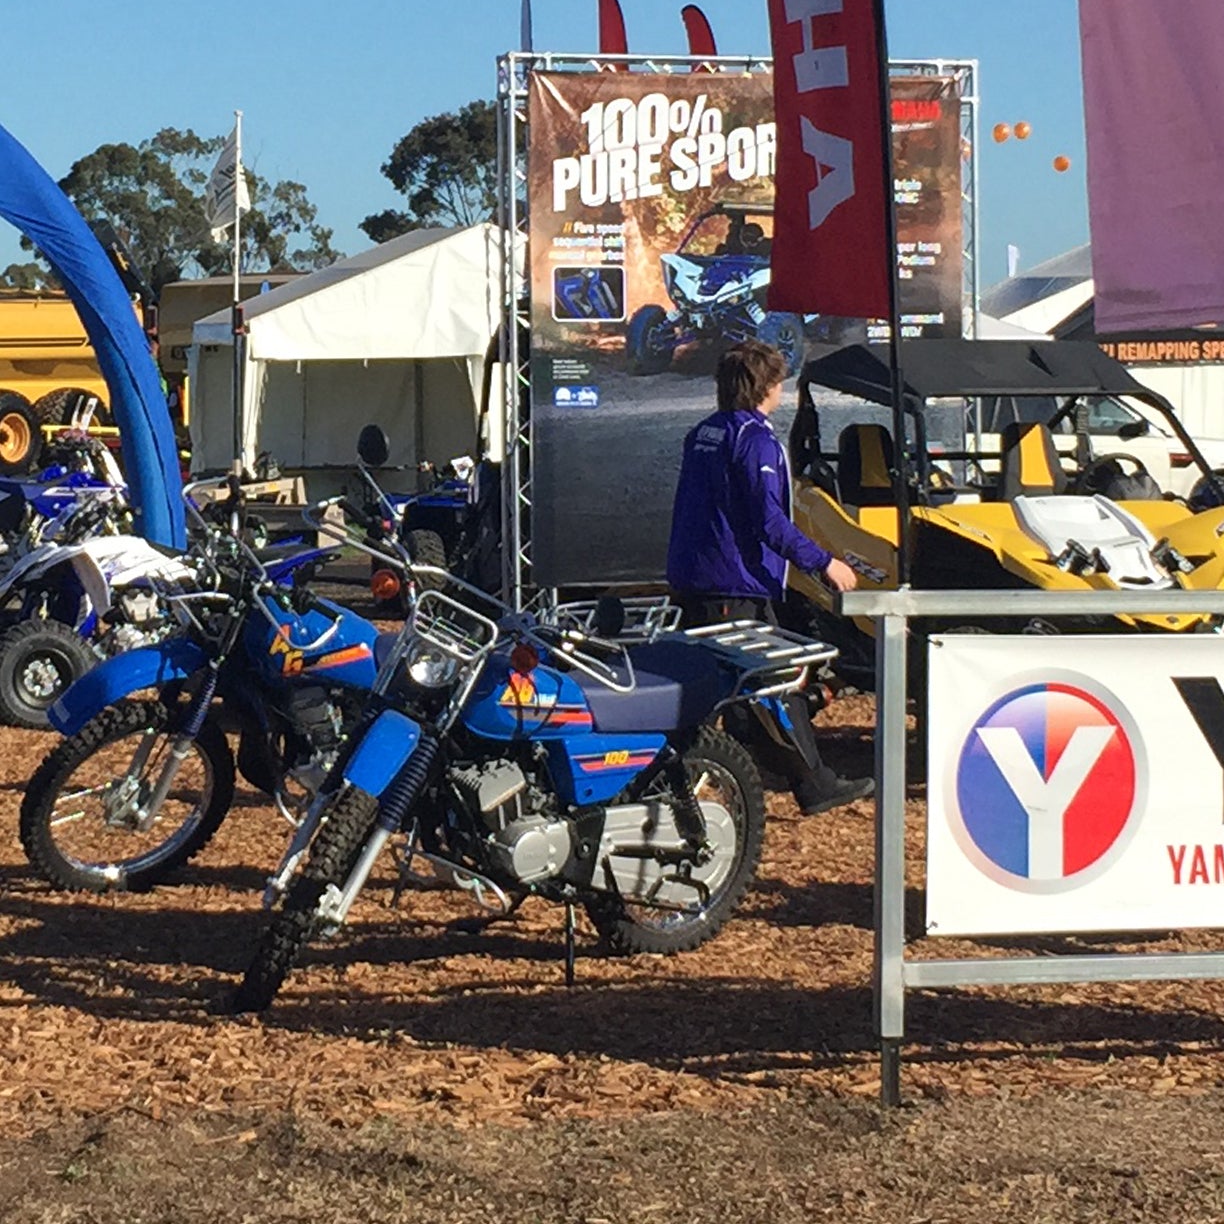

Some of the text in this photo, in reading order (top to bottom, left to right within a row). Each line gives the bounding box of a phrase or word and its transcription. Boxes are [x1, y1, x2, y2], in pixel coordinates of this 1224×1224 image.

[581, 93, 722, 156] 100%
[553, 140, 664, 212] PURE
[1117, 342, 1200, 361] REMAPPING
[603, 750, 630, 766] 100
